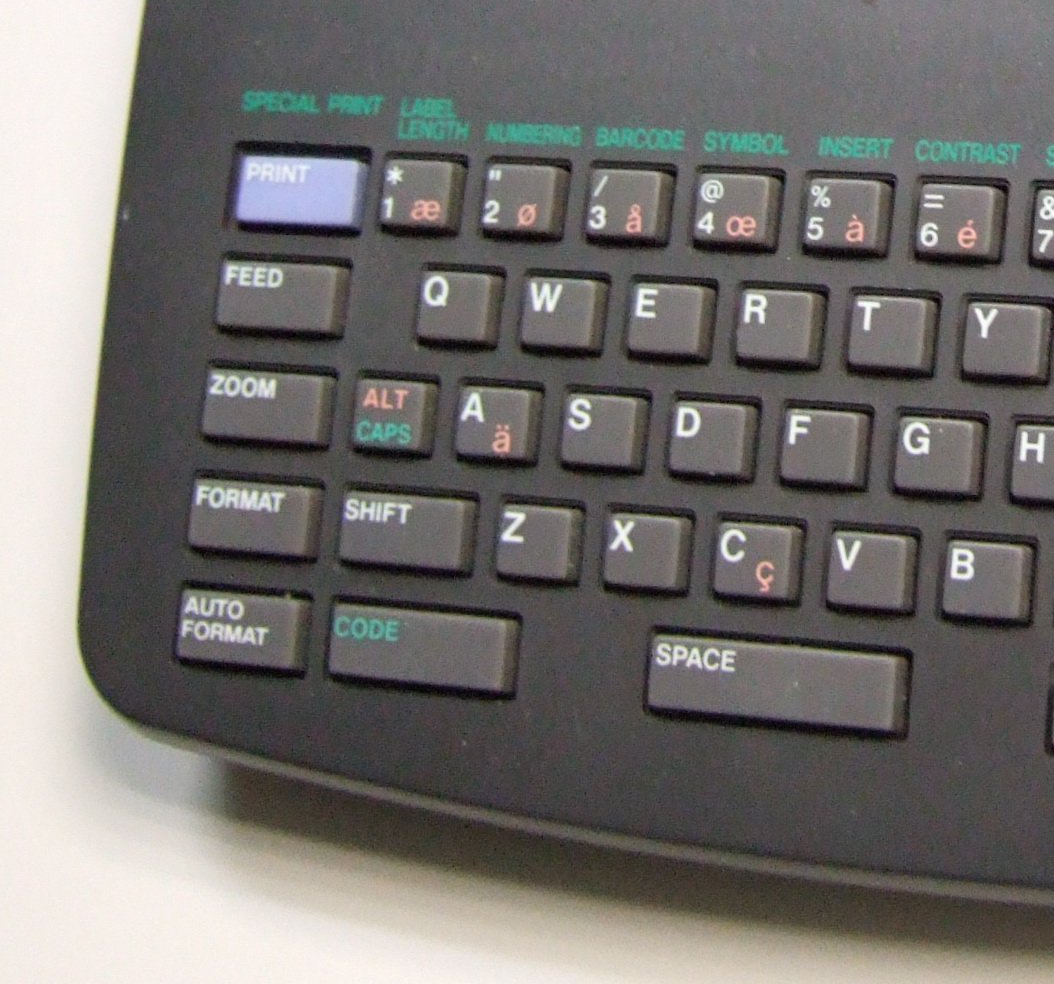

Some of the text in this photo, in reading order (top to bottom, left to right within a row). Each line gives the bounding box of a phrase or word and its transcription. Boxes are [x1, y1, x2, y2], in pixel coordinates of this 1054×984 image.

[242, 90, 384, 115] SPECIAL PRINT
[402, 98, 458, 117] LABEL
[398, 119, 470, 141] LENGTH
[486, 123, 581, 147] NUMBERING
[596, 126, 686, 151] BARCODE
[704, 131, 789, 156] SYMBOL
[818, 136, 895, 159] INSERT
[915, 140, 1022, 165] CONTRAST
[246, 163, 312, 184] PRINT
[701, 180, 723, 204] @
[811, 185, 831, 208] %
[384, 197, 395, 218] 1
[483, 200, 500, 224] 2
[589, 206, 607, 230] 3
[697, 212, 714, 235] 4
[806, 216, 823, 241] 5
[920, 223, 939, 248] 6
[1037, 230, 1054, 253] 7
[223, 266, 284, 289] FEED
[423, 276, 450, 307] Q
[530, 283, 564, 312] W
[634, 288, 659, 318] E
[744, 294, 768, 325] R
[857, 301, 881, 331] T
[974, 307, 999, 339] Y
[209, 375, 277, 400] ZOOM
[362, 387, 410, 410] ALT
[459, 392, 485, 423] A
[566, 399, 592, 431] S
[355, 420, 412, 444] CAPS
[674, 406, 700, 439] D
[788, 415, 811, 446] F
[902, 422, 931, 457] G
[1018, 431, 1046, 464] H
[194, 485, 286, 514] FORMAT
[343, 499, 413, 525] SHIFT
[502, 511, 526, 544] Z
[610, 519, 635, 553] X
[719, 529, 747, 564] C
[836, 539, 862, 572] V
[950, 548, 975, 581] B
[184, 595, 246, 621] AUTO
[180, 620, 269, 647] FORMAT
[333, 616, 400, 643] CODE
[655, 643, 738, 674] SPACE
